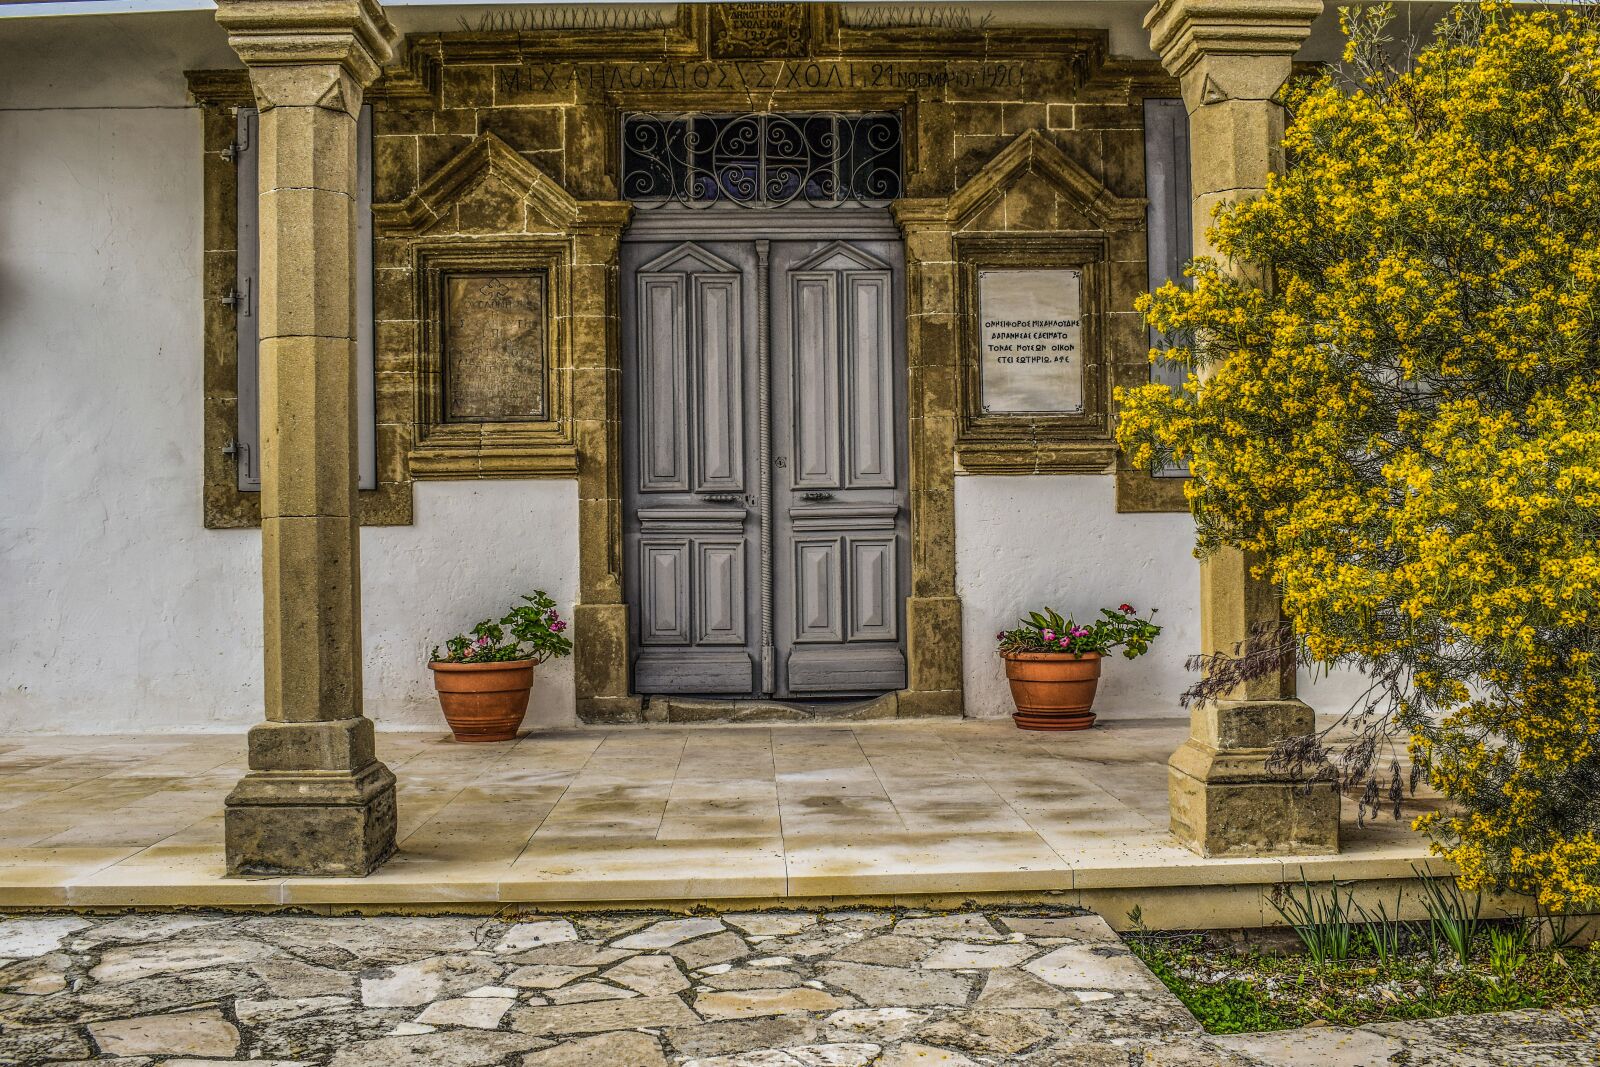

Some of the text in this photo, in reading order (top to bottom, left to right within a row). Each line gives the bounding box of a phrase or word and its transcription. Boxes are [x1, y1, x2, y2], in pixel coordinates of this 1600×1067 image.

[731, 10, 785, 19] ΔΗΜΟΤΙΚΟΝ
[733, 20, 783, 29] ΣΧΟΛΕΙΟΝ
[871, 64, 894, 88] 21
[985, 320, 1031, 328] ΟΝΗΣΙΦΟΡΟΣ
[1051, 344, 1075, 352] ΟΙΚΟΝ
